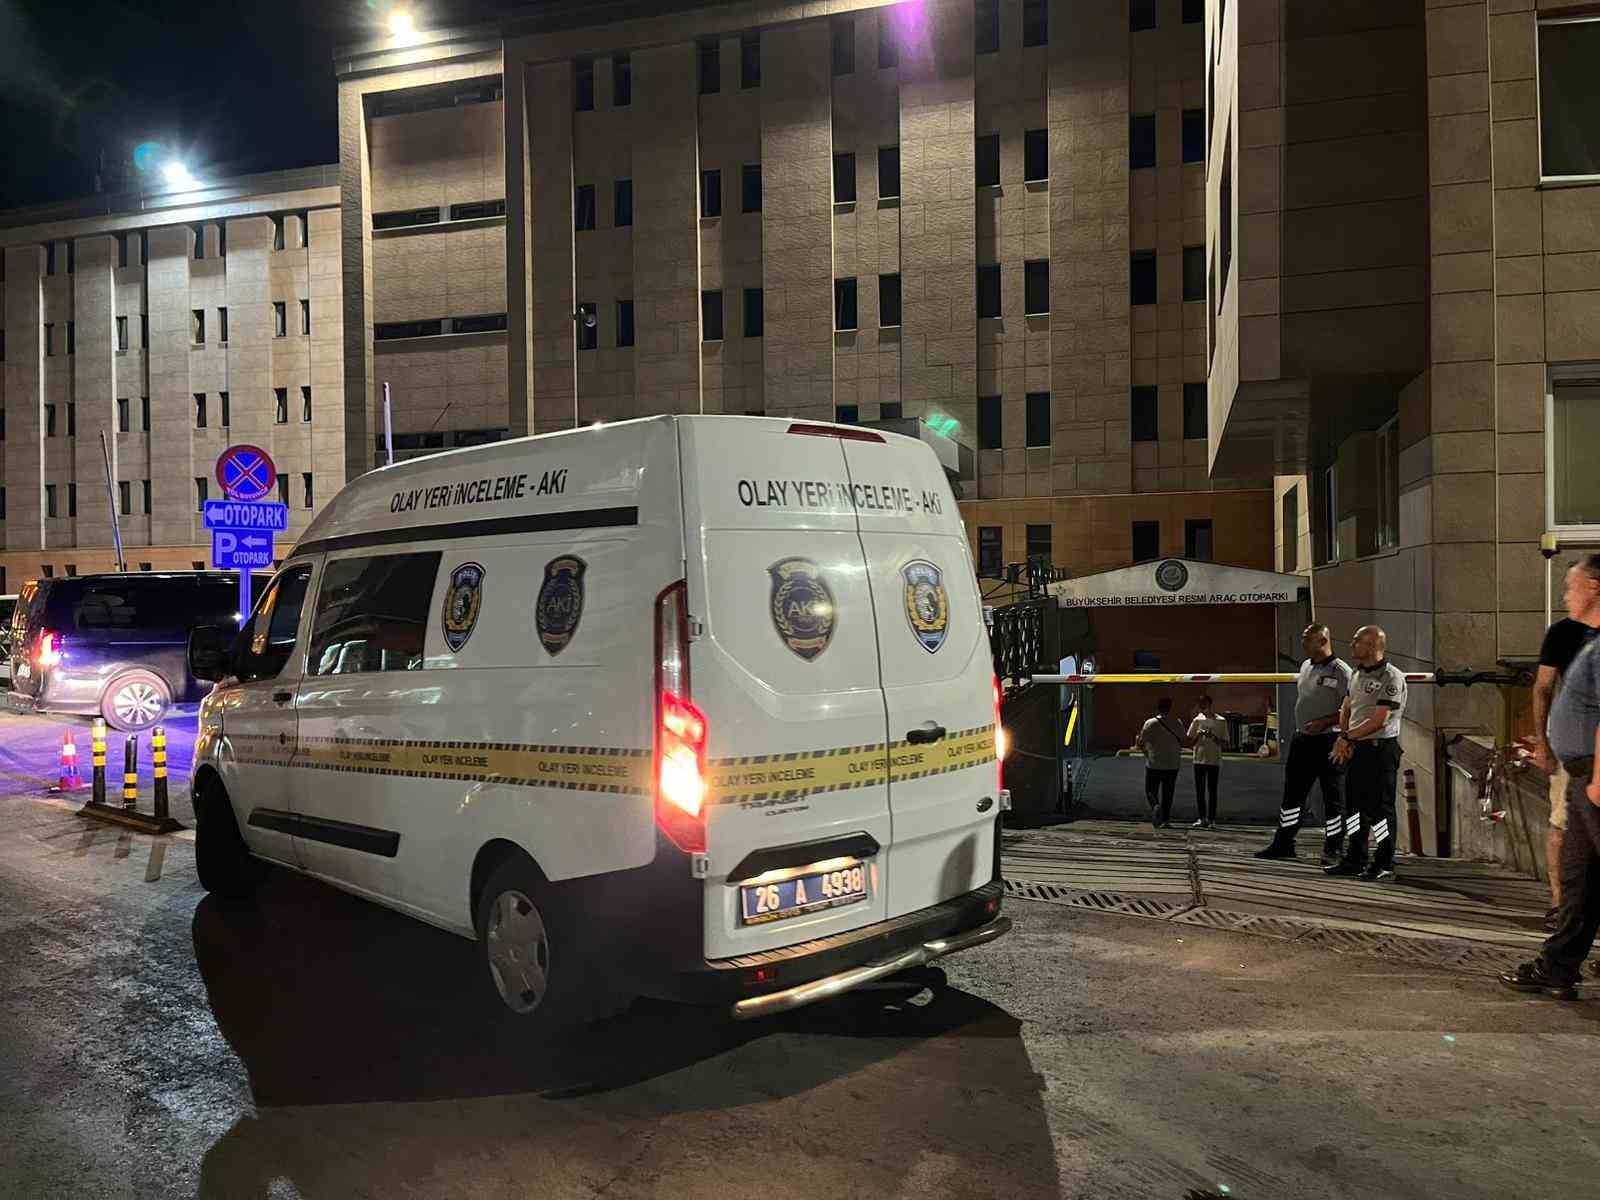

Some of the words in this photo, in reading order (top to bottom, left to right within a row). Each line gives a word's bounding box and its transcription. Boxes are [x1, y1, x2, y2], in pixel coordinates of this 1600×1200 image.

[390, 489, 423, 513] OLAY
[738, 479, 788, 507] OLAY
[224, 504, 283, 527] OTOPARK
[215, 532, 237, 564] P
[232, 551, 270, 564] OTOPARK
[755, 884, 780, 913] 26
[795, 879, 807, 905] A
[822, 866, 861, 898] 4938
